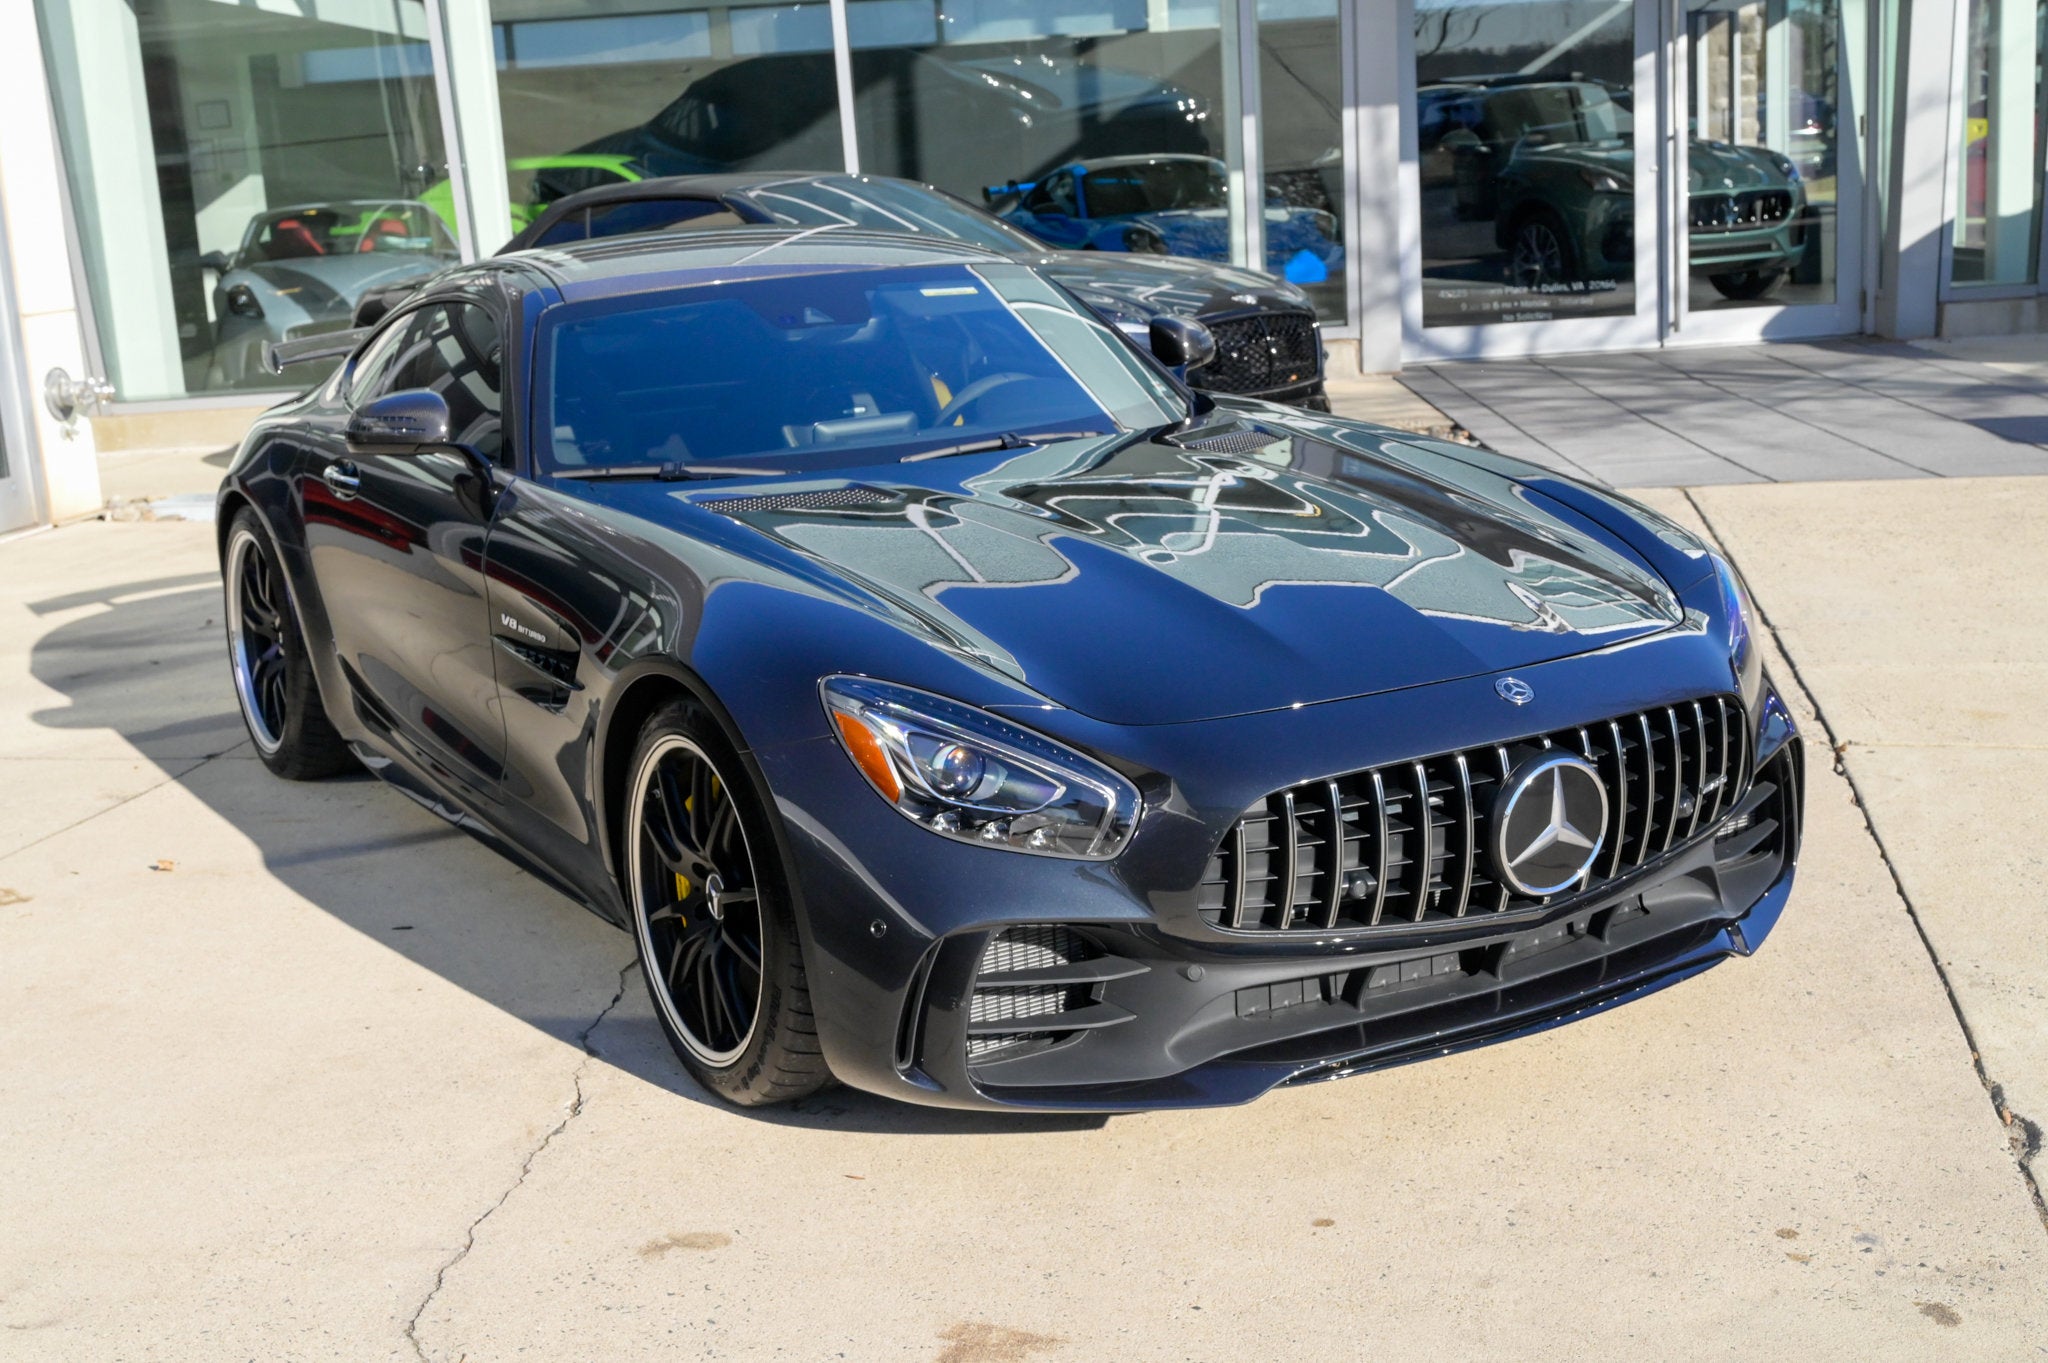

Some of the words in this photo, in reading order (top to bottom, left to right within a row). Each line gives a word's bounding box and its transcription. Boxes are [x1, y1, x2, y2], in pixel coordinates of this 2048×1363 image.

[1504, 286, 1528, 295] Place
[1571, 281, 1585, 291] VA
[501, 613, 518, 630] V8
[517, 624, 547, 643] BITURBO
